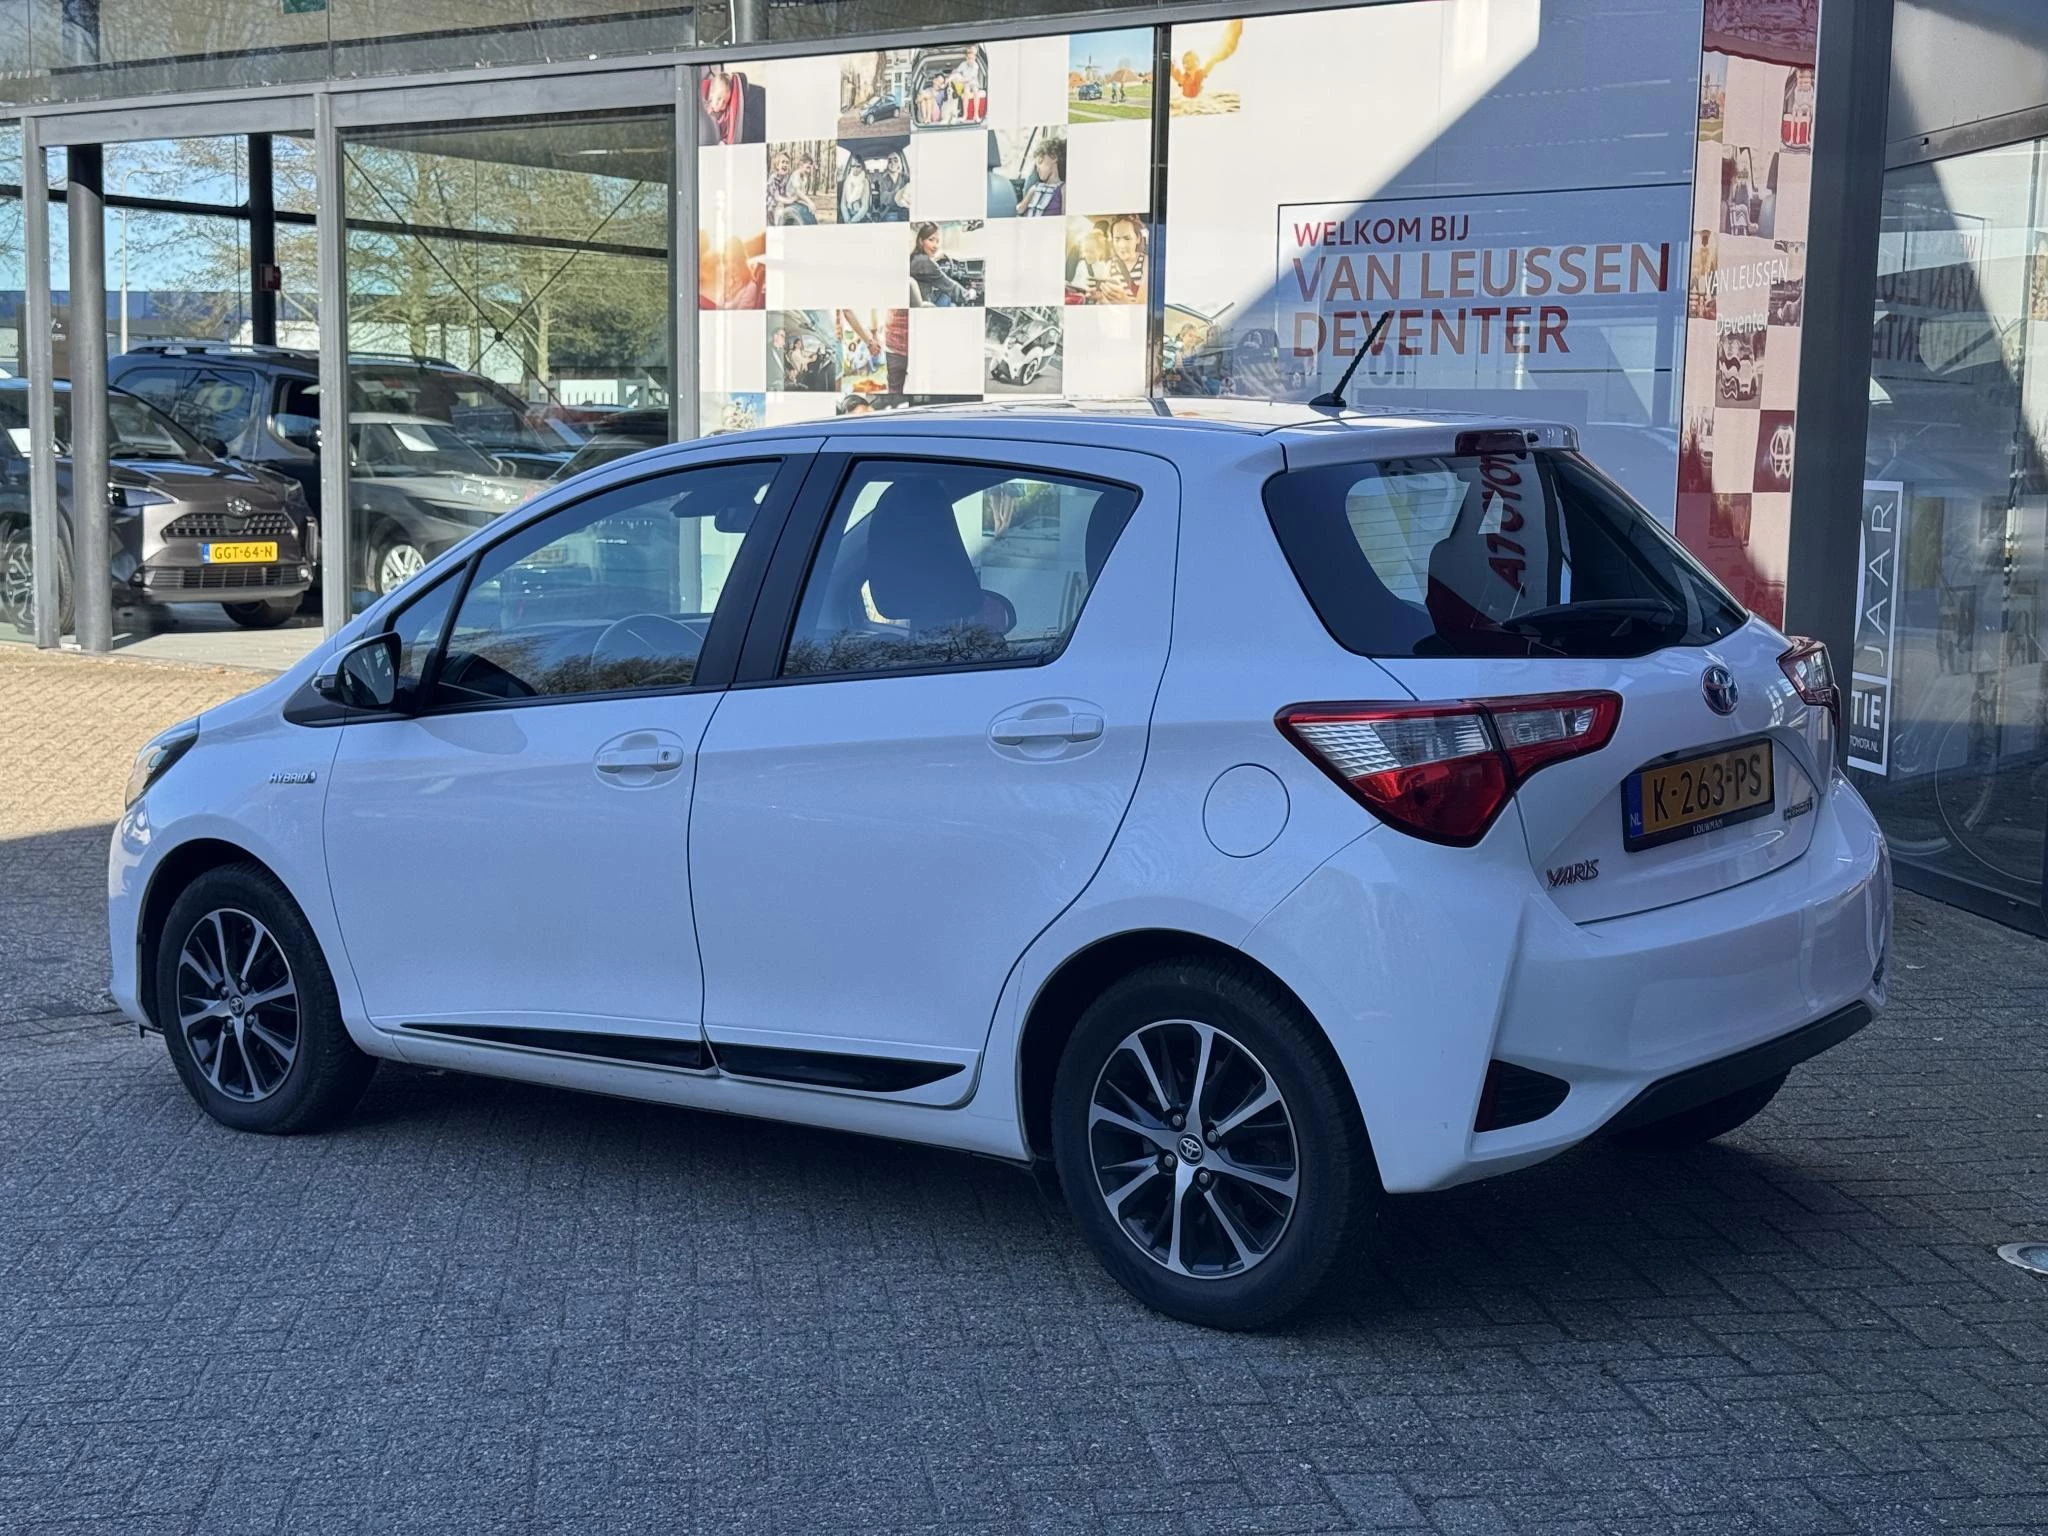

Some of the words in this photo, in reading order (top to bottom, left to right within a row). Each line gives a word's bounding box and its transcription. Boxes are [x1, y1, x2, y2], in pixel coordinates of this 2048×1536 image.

[1294, 216, 1422, 247] WELKOM
[1430, 214, 1470, 242] BIJ
[1292, 253, 1401, 303] VAN
[1420, 242, 1671, 299] LEUSSEN
[1704, 268, 1730, 295] VAN
[1732, 257, 1789, 290] LEUSSEN
[1293, 305, 1571, 358] DEVENTER
[1716, 311, 1770, 336] Deventer
[214, 546, 273, 560] GGT-64-N
[1863, 501, 1894, 669] JAAR
[1653, 753, 1762, 823] K-263-PS
[1546, 859, 1600, 888] YARIS
